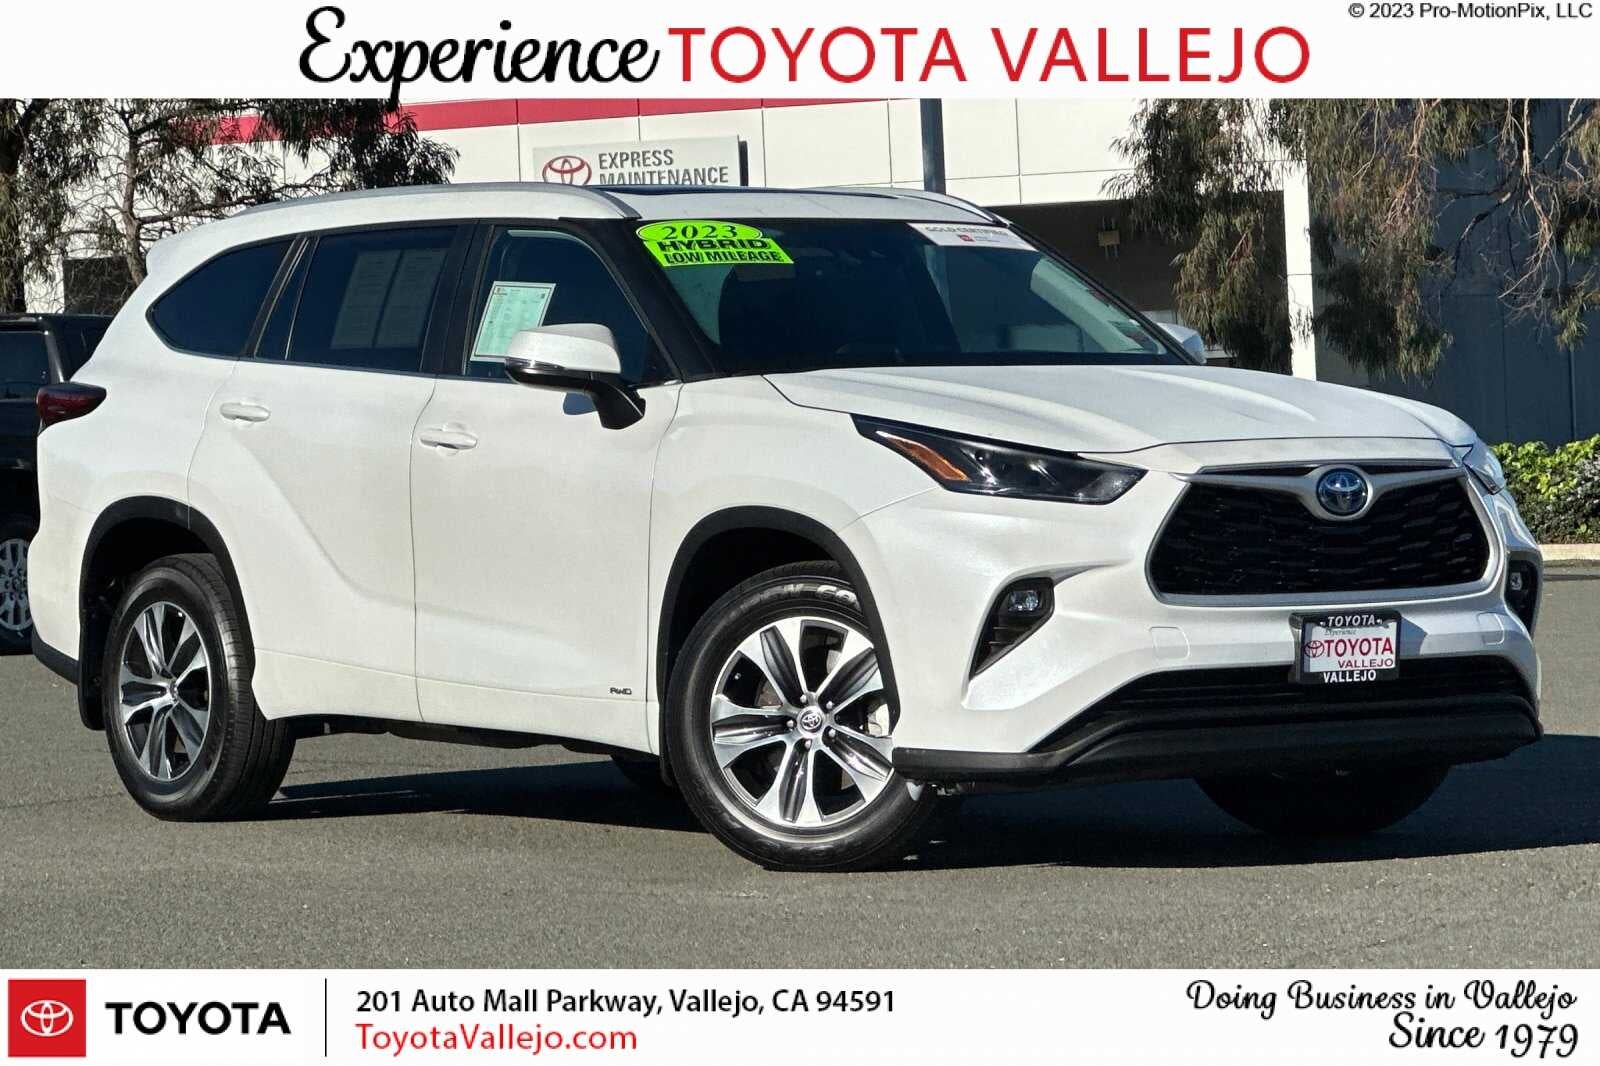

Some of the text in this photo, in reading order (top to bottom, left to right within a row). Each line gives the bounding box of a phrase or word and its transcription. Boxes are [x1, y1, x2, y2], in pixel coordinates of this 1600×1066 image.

[599, 150, 674, 169] EXPRESS
[600, 166, 729, 185] MAINTENANCE
[661, 225, 738, 239] 2023
[656, 239, 769, 250] HYBRID
[664, 251, 782, 264] LOW MILEAGE
[1327, 615, 1375, 627] TOYOTA
[1324, 638, 1394, 657] TOYOTA
[1337, 658, 1394, 669] VALLEJO
[1323, 670, 1377, 683] VALLEJO
